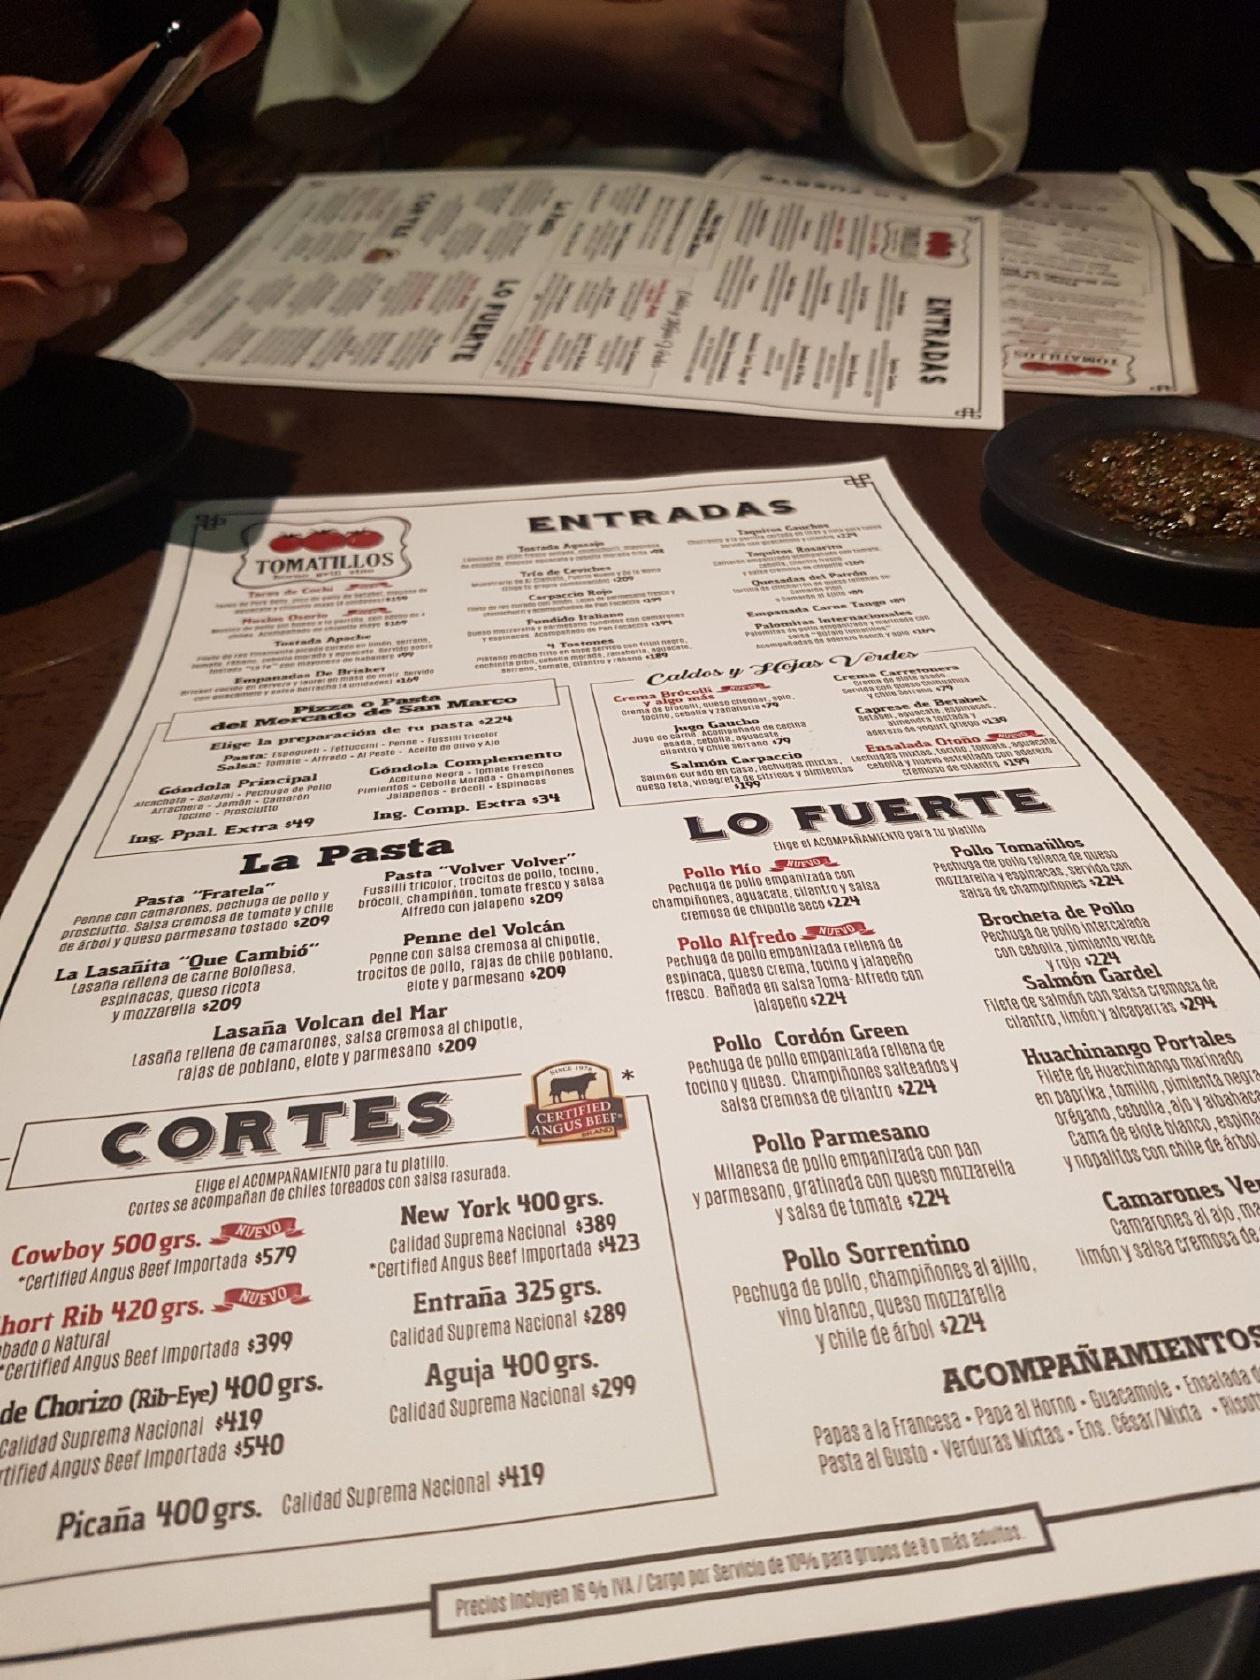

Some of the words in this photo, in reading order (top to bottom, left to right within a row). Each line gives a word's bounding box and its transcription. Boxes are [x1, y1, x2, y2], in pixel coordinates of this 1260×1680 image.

[493, 279, 520, 299] LO
[449, 303, 507, 362] FUERTE
[919, 297, 952, 385] ENTRADAS
[528, 500, 796, 533] ENTRADAS
[256, 553, 394, 577] TOMATILLOS
[526, 616, 575, 625] Fundido
[579, 613, 623, 621] Italiano
[746, 607, 809, 617] Empanada
[647, 668, 724, 686] Caldos
[729, 668, 744, 678] y
[749, 659, 823, 675] Hojas
[829, 650, 918, 667] Verdes
[210, 720, 248, 730] del
[254, 711, 356, 727] Mercado
[363, 708, 392, 716] de
[399, 704, 441, 713] San
[447, 698, 517, 709] Marco
[293, 703, 354, 714] Pizza
[381, 695, 441, 706] Pasta
[855, 704, 910, 715] Caprese
[914, 700, 930, 708] de
[935, 695, 988, 707] Betabel
[210, 741, 251, 751] Elige
[257, 738, 272, 746] la
[278, 729, 376, 746] preparación
[431, 721, 473, 732] pasta
[479, 715, 512, 725] $224
[674, 723, 704, 733] Jugo
[708, 718, 760, 729] Gaucho
[865, 740, 933, 753] Ensalada
[935, 735, 982, 746] Otoño
[369, 762, 438, 775] Góndola
[445, 752, 562, 770] Complemento
[670, 759, 728, 769] Salmón
[731, 753, 802, 764] Carpaccio
[158, 782, 231, 795] Góndola
[237, 773, 317, 788] Principal
[373, 811, 407, 821] Ing.
[414, 805, 469, 816] Comp.
[476, 799, 526, 810] Extra
[532, 793, 560, 804] $34
[683, 813, 773, 842] LO
[790, 787, 1056, 837] FUERTE
[128, 834, 164, 844] Ing.
[171, 827, 217, 841] Ppal.
[224, 824, 278, 835] Extra
[285, 817, 315, 828] $49
[239, 853, 300, 875] La
[317, 838, 454, 867] Pasta
[950, 844, 994, 857] Pollo
[995, 838, 1084, 853] Tomatillos
[385, 870, 432, 881] Pasta
[683, 866, 725, 879] Pollo
[730, 863, 761, 875] Mío
[787, 859, 821, 868] NUEVO
[134, 895, 184, 907] Pasta
[978, 910, 1062, 926] Brocheta
[1065, 905, 1088, 919] de
[1088, 901, 1135, 916] Pollo
[403, 932, 461, 946] Penne
[469, 925, 496, 940] del
[502, 920, 565, 936] Volcán
[677, 935, 722, 951] Pollo
[729, 928, 797, 949] Alfredo
[818, 924, 853, 936] NUEVO
[54, 968, 78, 982] La
[85, 959, 170, 978] Lasañita
[1022, 971, 1097, 990] Salmón
[1098, 963, 1163, 982] Gardel
[213, 1020, 287, 1041] Lasaña
[295, 1015, 364, 1032] Volcan
[372, 1007, 402, 1025] del
[410, 1004, 448, 1020] Mar
[713, 1034, 762, 1053] Pollo
[775, 1027, 845, 1047] Cordón
[850, 1024, 909, 1040] Green
[1021, 1042, 1152, 1065] Huachinango
[1153, 1030, 1236, 1052] Portales
[688, 1058, 744, 1074] Pechuga
[747, 1055, 762, 1069] de
[765, 1052, 798, 1069] pollo
[800, 1045, 879, 1065] empanizada
[881, 1042, 927, 1057] rellena
[929, 1039, 945, 1052] de
[536, 1102, 611, 1123] CERTIFIED
[101, 1091, 455, 1169] CORTES
[531, 1119, 582, 1135] ANGUS
[752, 1132, 806, 1153] Pollo
[810, 1125, 930, 1148] Parmesano
[401, 1205, 449, 1225] New
[457, 1196, 511, 1219] York
[517, 1191, 560, 1213] 400
[563, 1193, 603, 1214] grs.
[1102, 1184, 1225, 1211] Camarones
[12, 1240, 104, 1266] Cowboy
[112, 1232, 156, 1256] 500
[159, 1234, 201, 1256] grs.
[235, 1221, 281, 1238] NUEVO
[390, 1234, 440, 1254] Calidad
[444, 1229, 503, 1248] Suprema
[508, 1220, 566, 1241] Nacional
[576, 1213, 616, 1234] $389
[441, 1254, 484, 1271] Angus
[488, 1248, 516, 1266] Beef
[522, 1241, 591, 1263] Importada
[598, 1233, 640, 1253] $423
[783, 1242, 840, 1271] Pollo
[846, 1234, 970, 1264] Sorrentino
[413, 1286, 507, 1314] Entraña
[515, 1279, 555, 1303] 325
[559, 1280, 601, 1304] grs.
[0, 1313, 55, 1336] hort
[61, 1304, 103, 1329] Rib
[112, 1298, 157, 1322] 420
[161, 1300, 204, 1324] grs.
[240, 1287, 287, 1305] NUEVO
[425, 1358, 494, 1392] Aguja
[502, 1351, 549, 1377] 400
[554, 1353, 599, 1379] grs.
[943, 1328, 1260, 1394] ACOMPAÑAMIENTOS
[0, 1400, 27, 1425] de
[35, 1389, 123, 1420] Chorizo
[129, 1381, 218, 1413] (Rib-Eye)
[225, 1372, 274, 1400] 400
[278, 1375, 323, 1401] grs.
[283, 1488, 341, 1515] Calidad
[347, 1483, 416, 1508] Suprema
[423, 1471, 490, 1498] Nacional
[498, 1462, 544, 1488] $419
[56, 1506, 145, 1541] Picaña
[156, 1497, 209, 1527] 400
[213, 1500, 262, 1530] grs.
